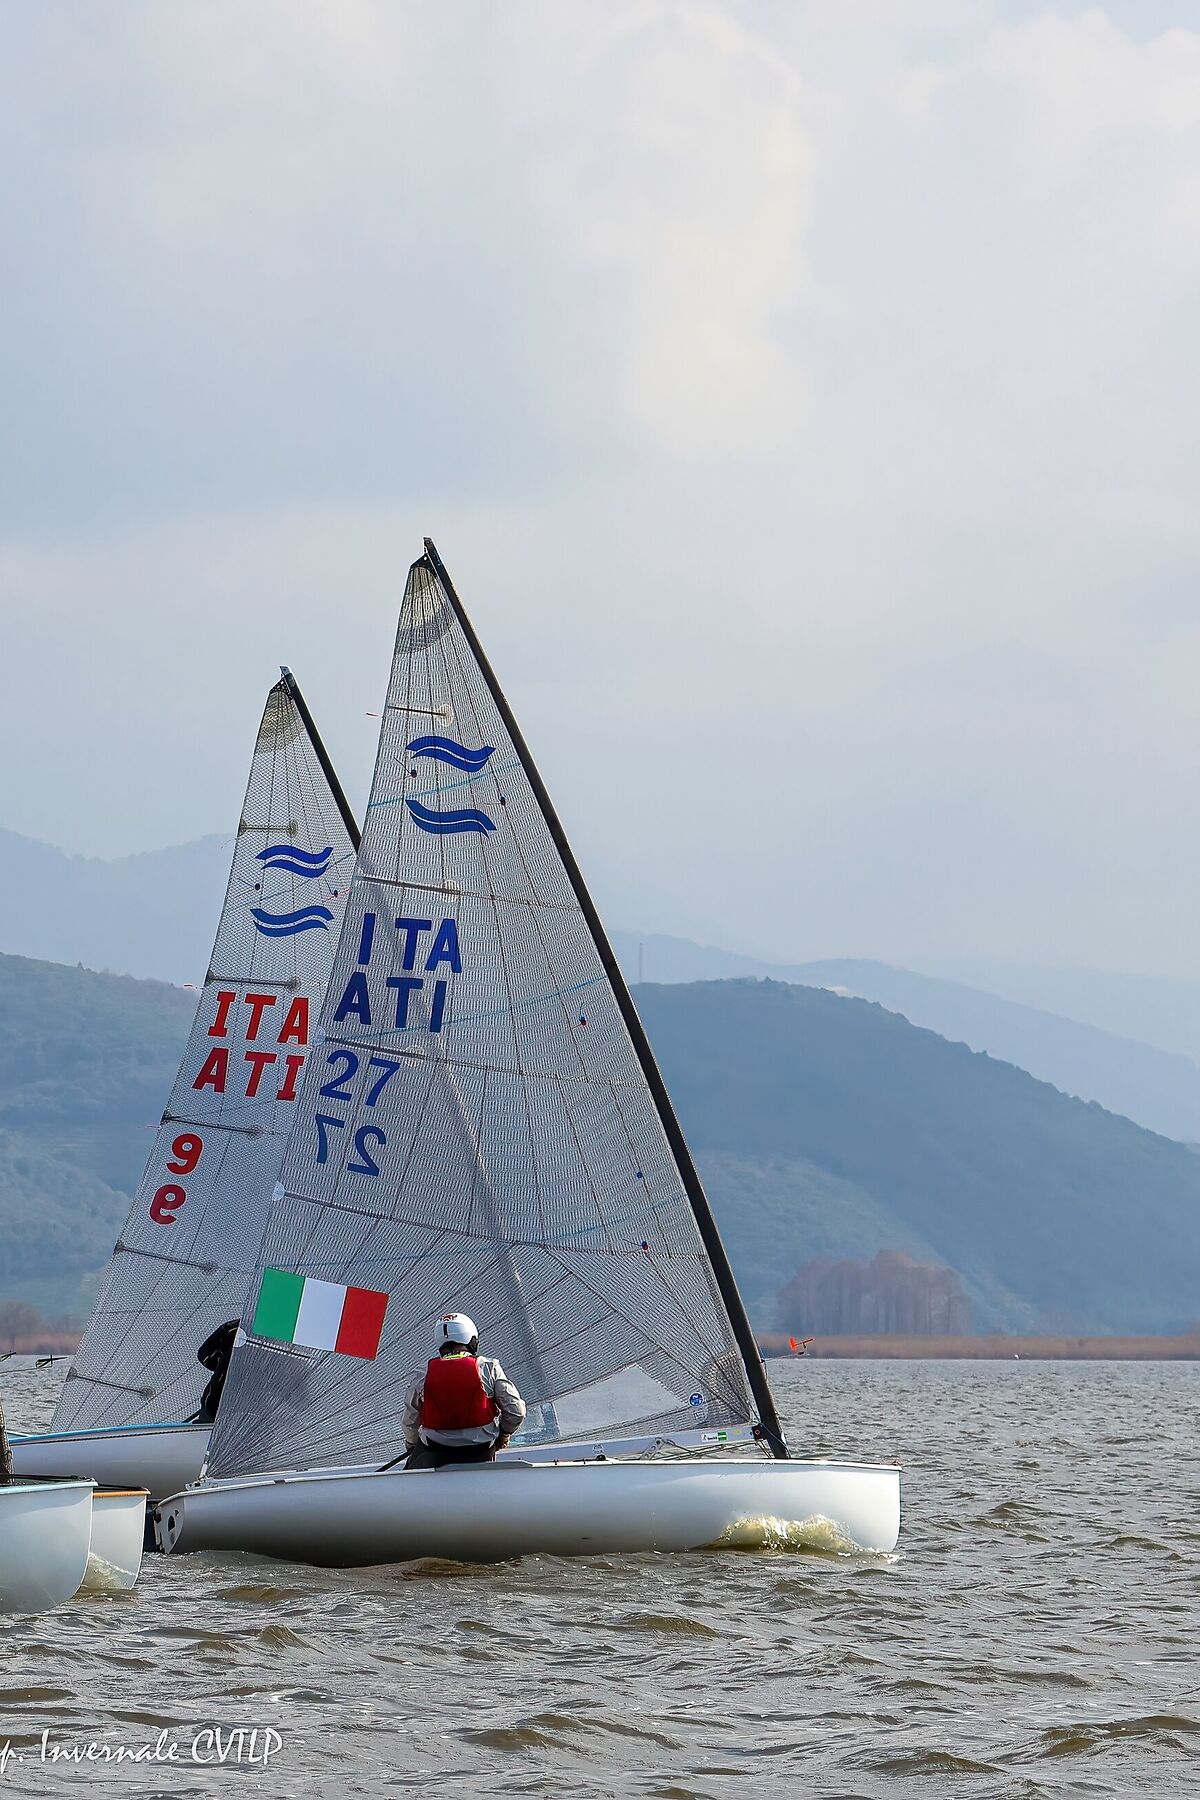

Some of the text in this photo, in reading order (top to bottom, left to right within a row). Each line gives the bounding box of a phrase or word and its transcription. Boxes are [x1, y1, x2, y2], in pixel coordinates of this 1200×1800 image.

[357, 912, 462, 973] ITA
[207, 990, 309, 1045] ITA
[319, 1049, 401, 1107] 27
[165, 1132, 204, 1176] 9
